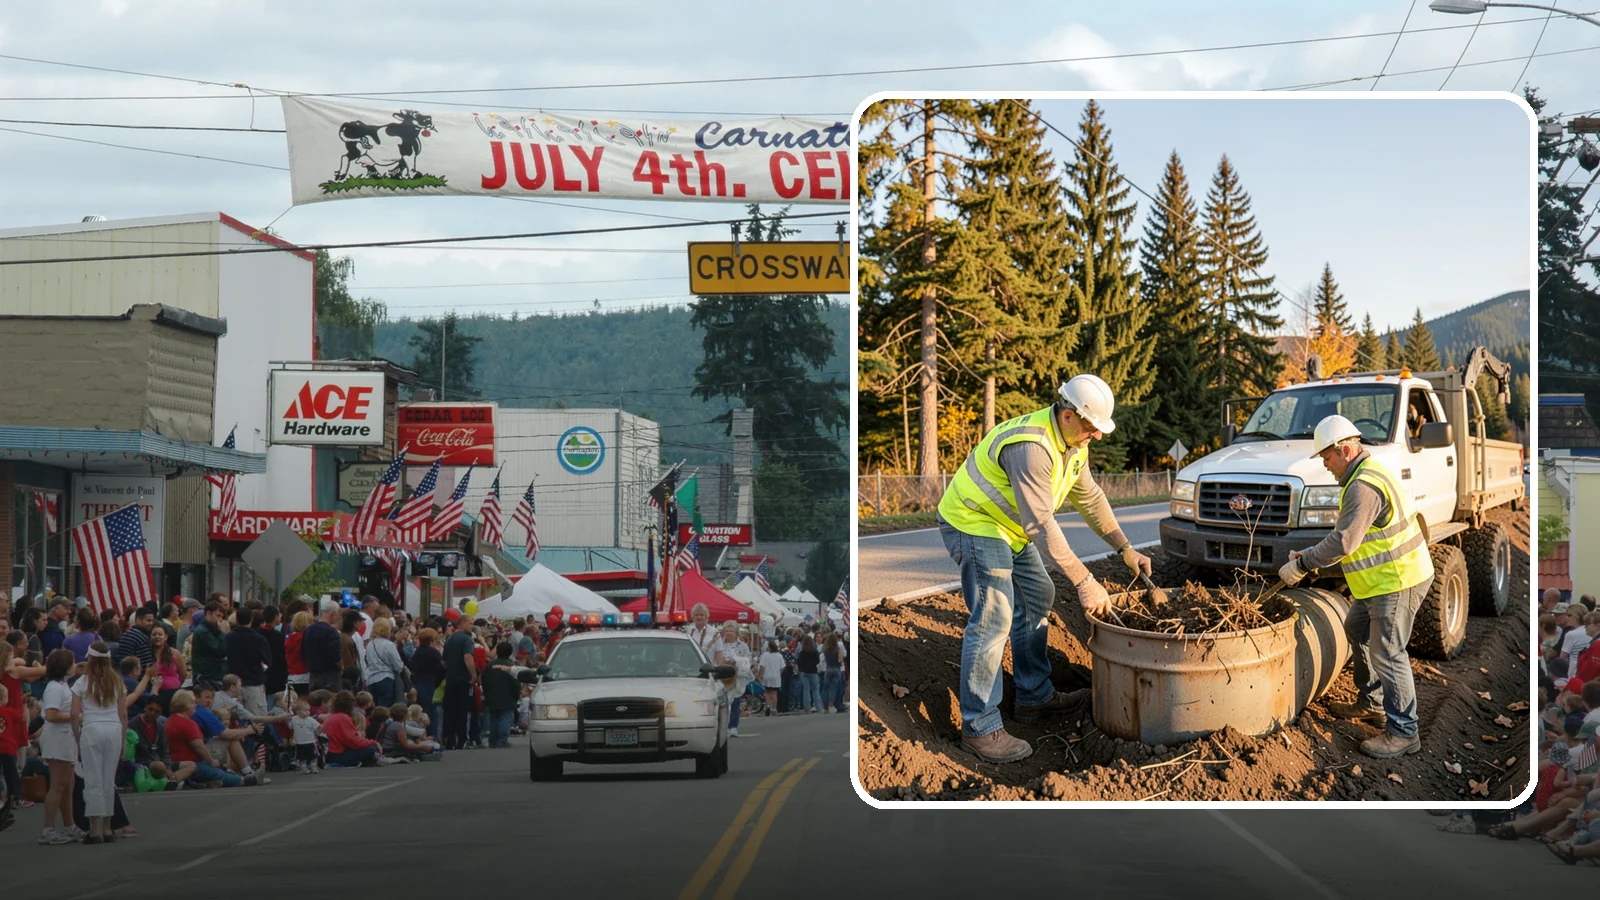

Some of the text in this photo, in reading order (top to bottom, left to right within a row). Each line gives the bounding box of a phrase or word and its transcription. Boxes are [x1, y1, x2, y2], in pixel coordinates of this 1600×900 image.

[481, 140, 605, 193] JULY
[632, 149, 746, 198] 4th.
[697, 254, 850, 280] CROSSWA
[282, 379, 373, 421] ACE
[405, 409, 485, 421] CEDAR LOG
[283, 421, 371, 437] Hardware
[416, 428, 478, 447] Coca-Cola
[353, 467, 384, 480] Simpl
[95, 484, 124, 494] Vincent
[126, 485, 136, 495] de
[137, 485, 155, 495] Paul
[80, 503, 154, 522] THT
[688, 526, 741, 536] CRNATION
[699, 535, 730, 543] GLASS
